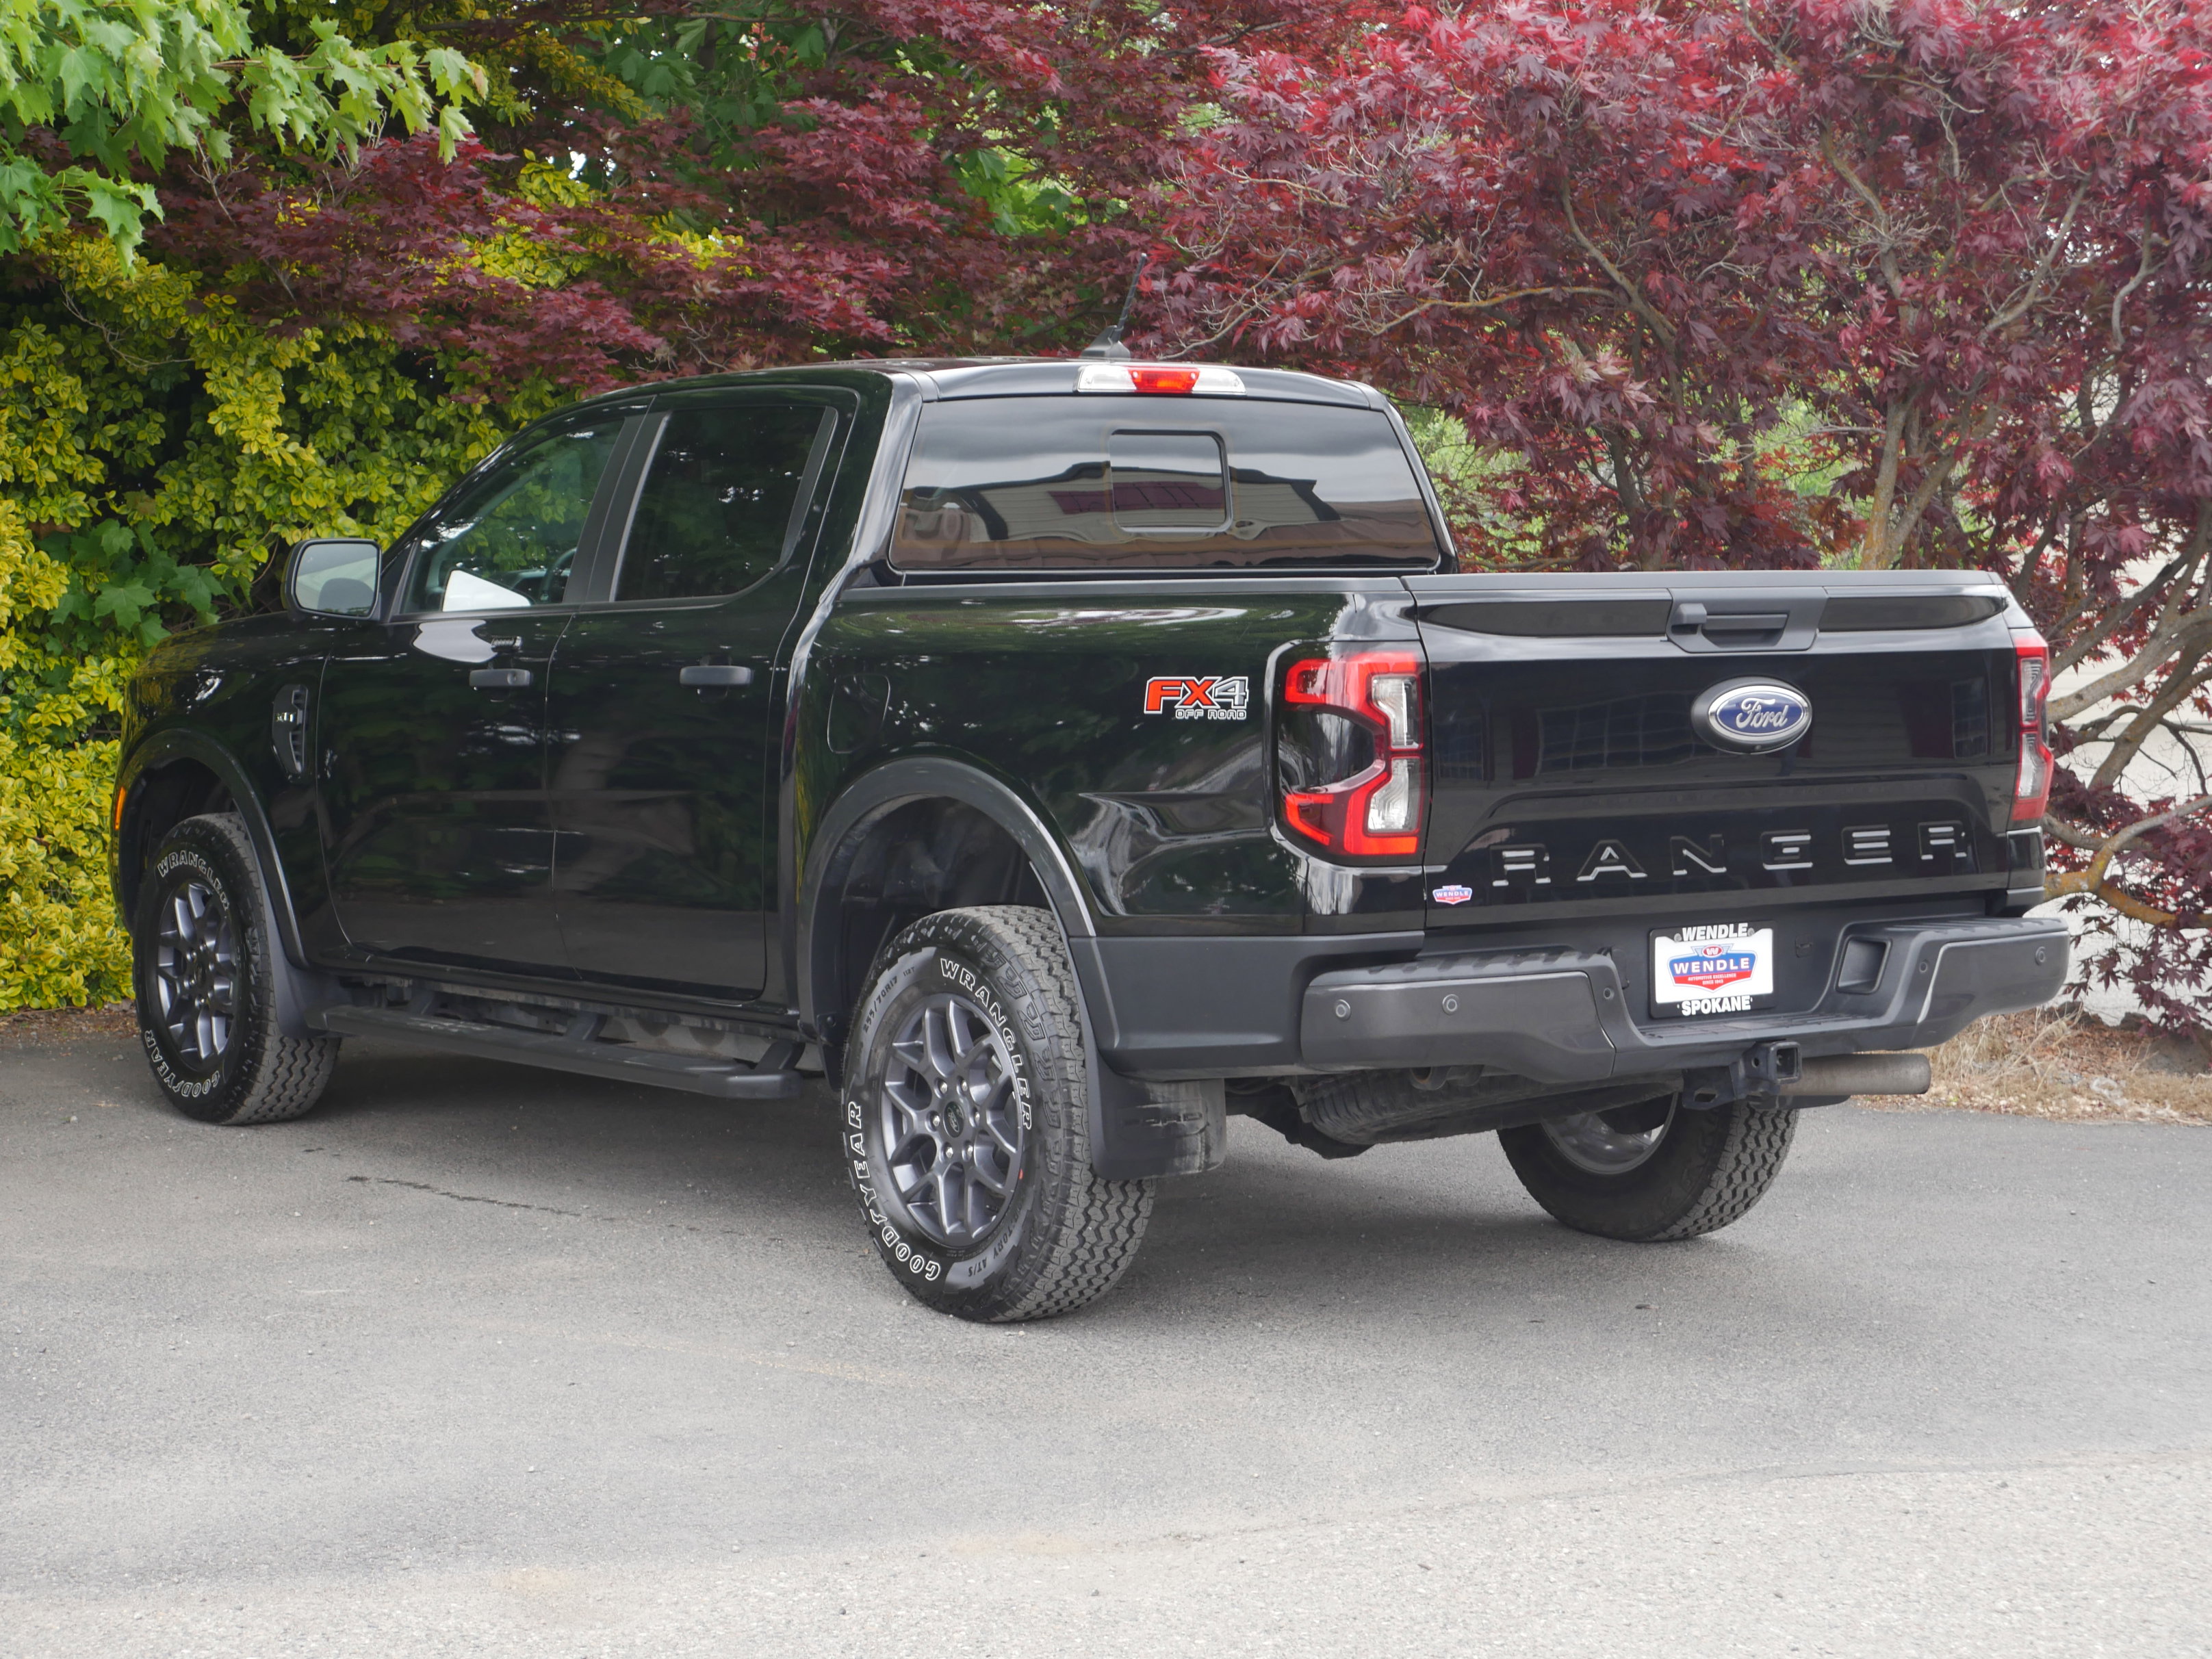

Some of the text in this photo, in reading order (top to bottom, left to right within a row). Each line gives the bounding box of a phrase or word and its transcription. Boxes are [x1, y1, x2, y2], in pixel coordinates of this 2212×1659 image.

[1144, 676, 1249, 714] FX4
[1736, 697, 1789, 729] Ford
[1175, 709, 1247, 720] OFF ROAD
[1490, 821, 1966, 887] RANGER
[157, 849, 230, 911] WRANGLER
[1682, 923, 1749, 942] WENDLE
[1673, 957, 1750, 975] WENDLE
[1682, 995, 1751, 1016] SPOKANE
[940, 958, 1031, 1130] WRANGLER
[144, 1029, 220, 1098] GOODYEAR
[848, 1101, 941, 1281] GOODYEAR
